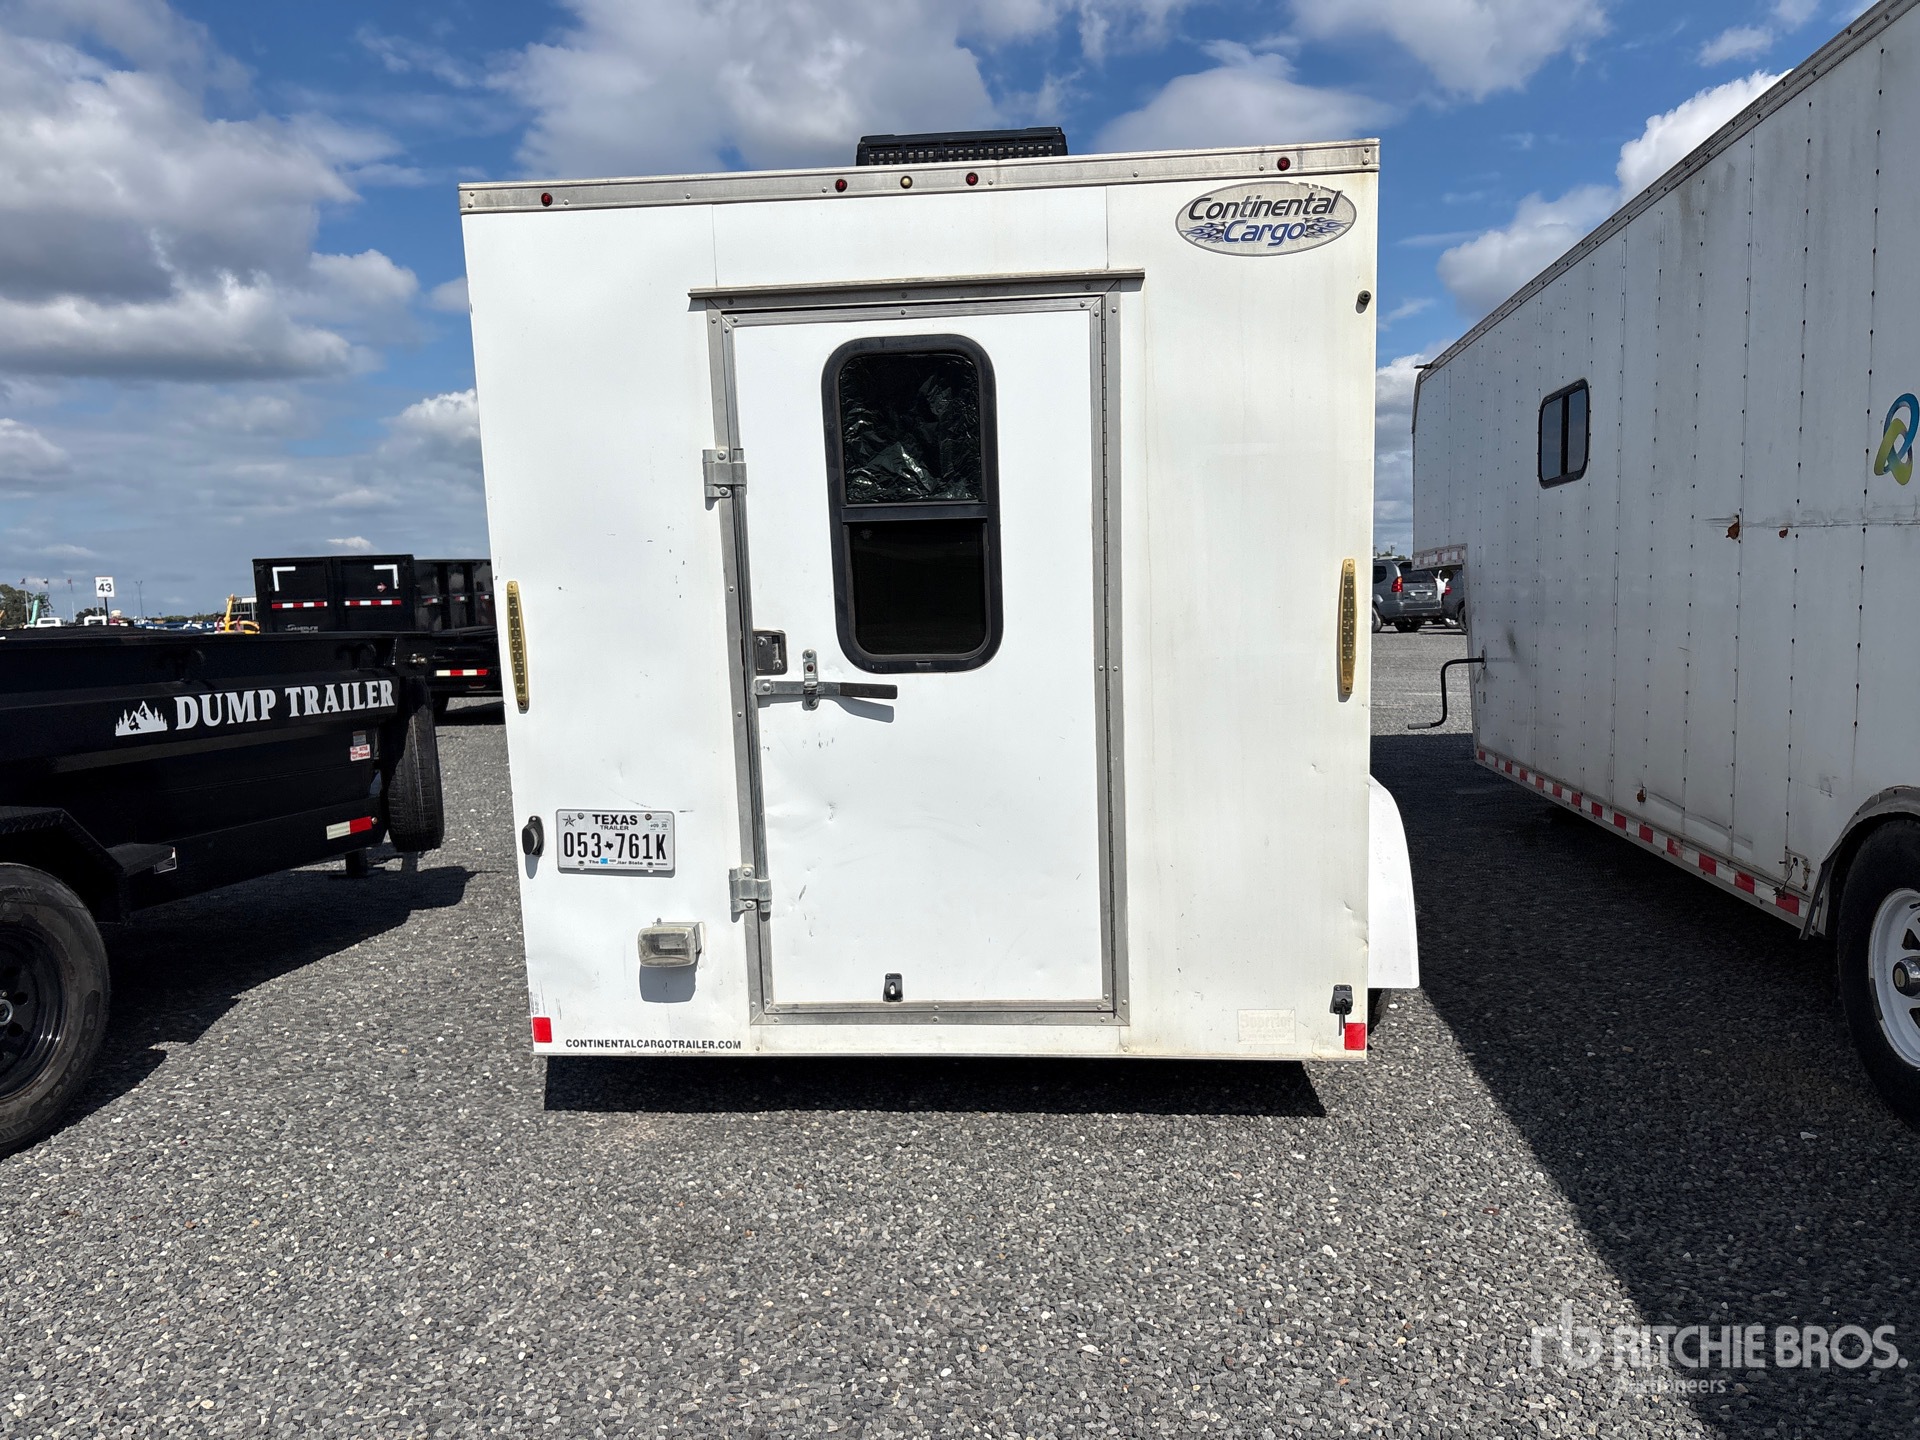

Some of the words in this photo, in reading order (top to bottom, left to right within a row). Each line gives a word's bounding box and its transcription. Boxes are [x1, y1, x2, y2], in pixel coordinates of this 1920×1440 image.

[1223, 219, 1306, 247] Cargo
[98, 582, 112, 592] 43
[174, 689, 276, 731] DUMP
[285, 679, 396, 718] TRAILER
[592, 814, 638, 826] TEXAS
[565, 1038, 742, 1050] CONTINENTALCARGOTRAILER.COM
